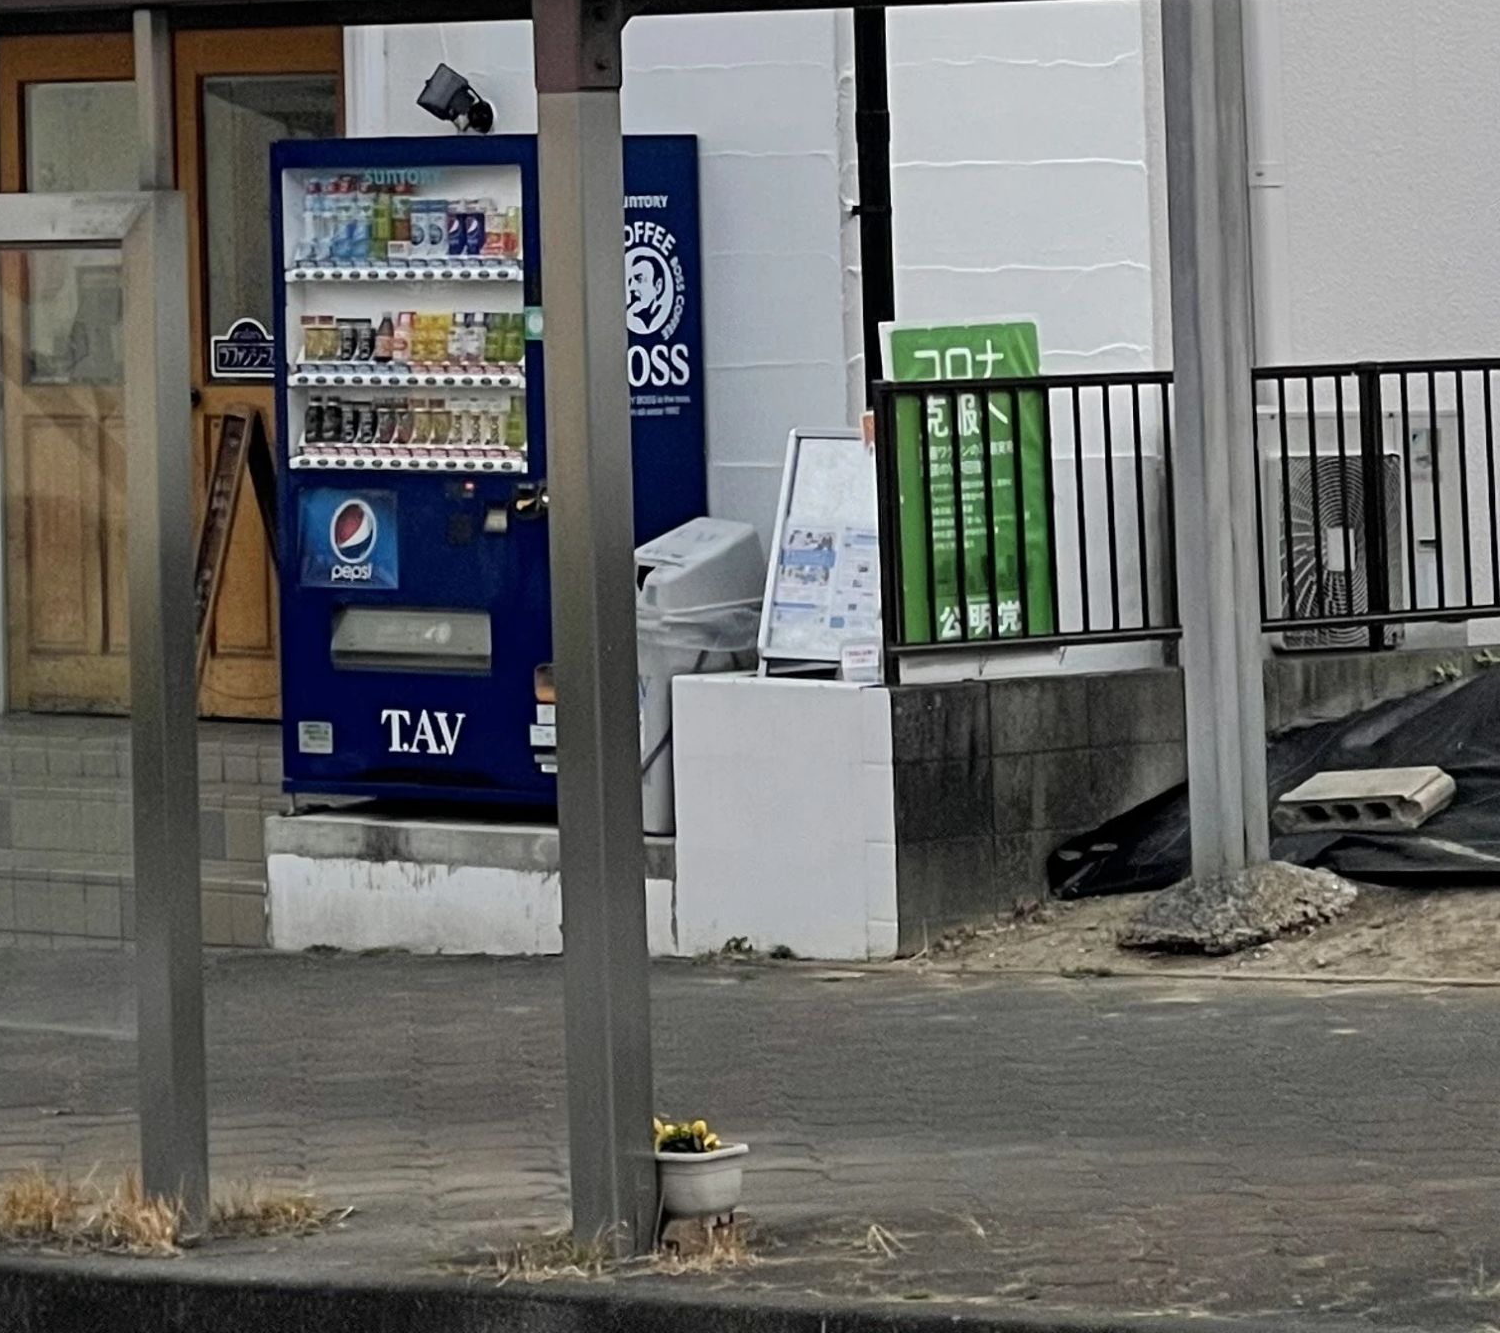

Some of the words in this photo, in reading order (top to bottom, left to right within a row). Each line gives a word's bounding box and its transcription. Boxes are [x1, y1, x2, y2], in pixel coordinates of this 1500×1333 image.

[624, 195, 668, 209] UNTORY
[624, 221, 676, 256] OFFEE
[670, 256, 685, 292] BOSS
[627, 343, 690, 387] OSS
[914, 339, 1004, 380] コロナ
[331, 563, 373, 582] pepsi
[940, 600, 1023, 638] 公明党
